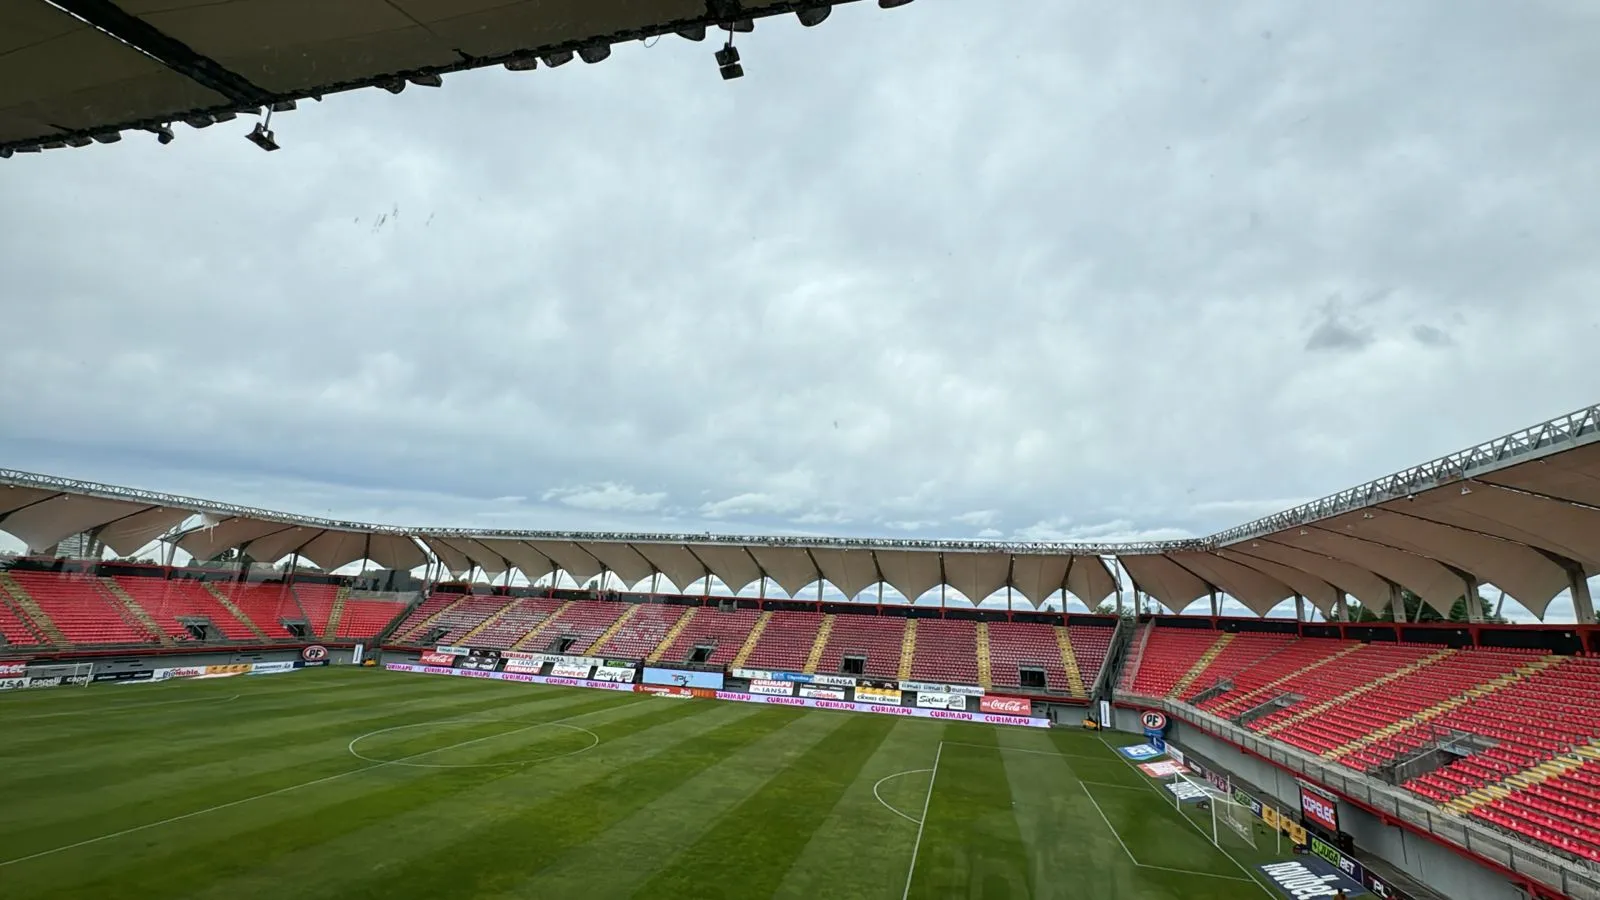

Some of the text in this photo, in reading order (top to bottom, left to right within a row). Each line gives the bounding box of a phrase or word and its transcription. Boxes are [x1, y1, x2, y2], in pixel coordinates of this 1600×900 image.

[309, 649, 321, 657] PF
[501, 651, 533, 660] CURIMAPU
[424, 667, 453, 675] CURIMAPU
[507, 665, 539, 673] CURIMAPU
[460, 670, 491, 678] CURIMAPU
[501, 673, 533, 681] CURIMAPU
[545, 677, 578, 686] CURIMAPU
[753, 679, 792, 687] CURIMAPU
[826, 677, 853, 685] IANSA
[586, 681, 620, 690] CURIMAPU
[951, 687, 984, 695] eurofarma
[766, 697, 805, 705] CURIMAPU
[815, 700, 855, 710] CURIMAPU
[870, 705, 913, 715] CURIMAPU
[930, 710, 973, 720] CURIMAPU
[984, 715, 1030, 725] CURIMAPU
[1146, 714, 1159, 726] PF
[1303, 795, 1336, 826] COPELEC
